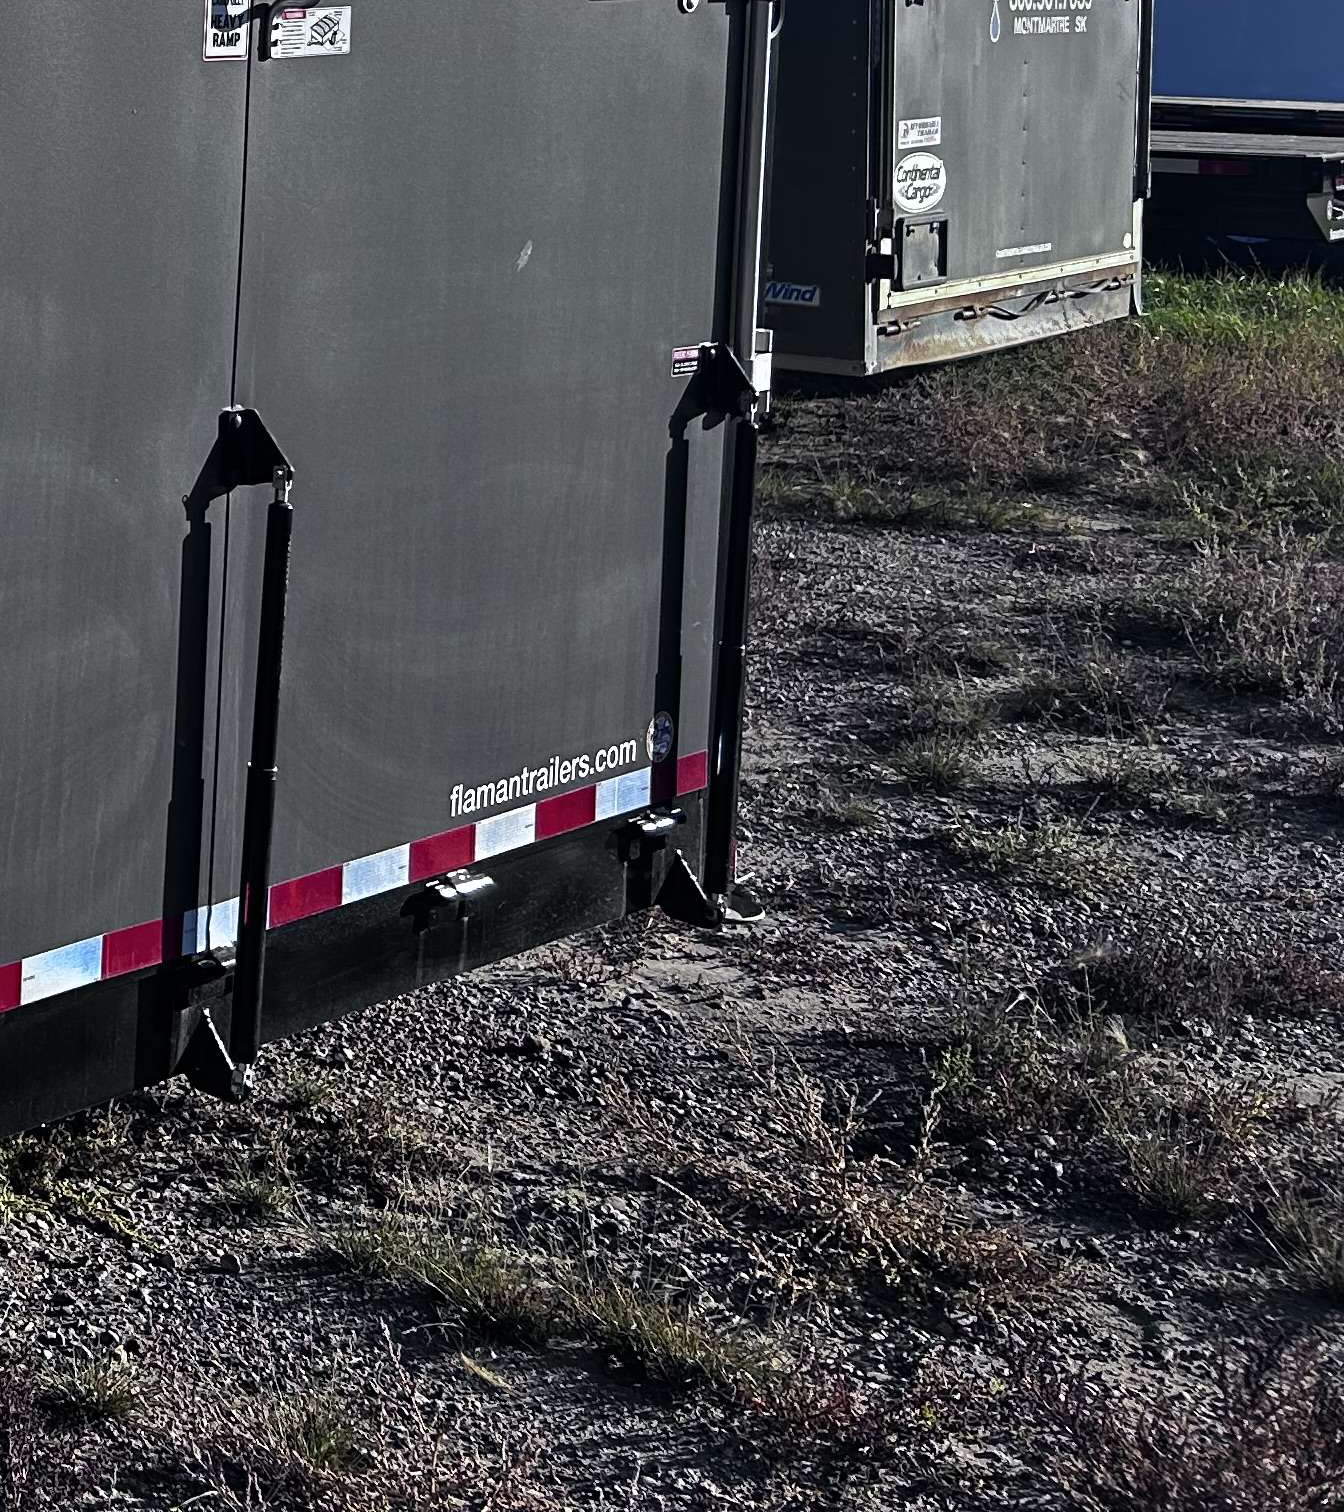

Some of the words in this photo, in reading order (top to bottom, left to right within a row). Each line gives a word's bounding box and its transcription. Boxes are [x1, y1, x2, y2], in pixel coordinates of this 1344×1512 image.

[212, 13, 244, 29] HEAVY
[1075, 15, 1088, 33] SK
[212, 32, 241, 48] RAMP
[897, 162, 942, 183] Continental
[905, 183, 934, 204] Cargo
[450, 739, 637, 817] flamantrailers.com
